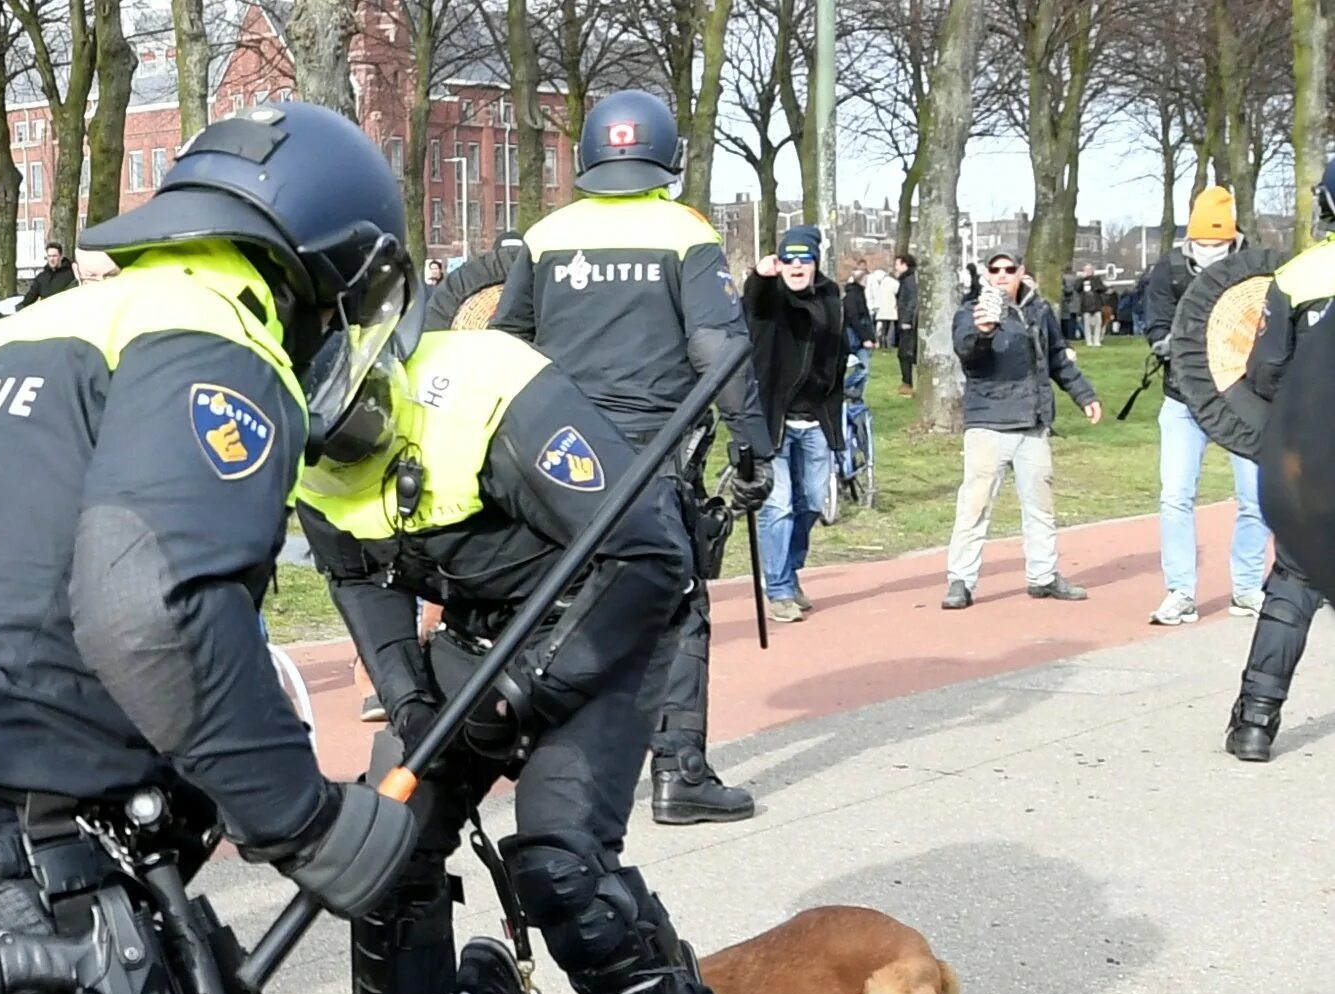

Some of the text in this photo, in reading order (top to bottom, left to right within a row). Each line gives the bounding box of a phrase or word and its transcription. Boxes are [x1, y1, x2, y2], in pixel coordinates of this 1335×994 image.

[554, 250, 661, 290] POLITIE
[424, 375, 450, 408] HG
[196, 392, 268, 439] POLITIE
